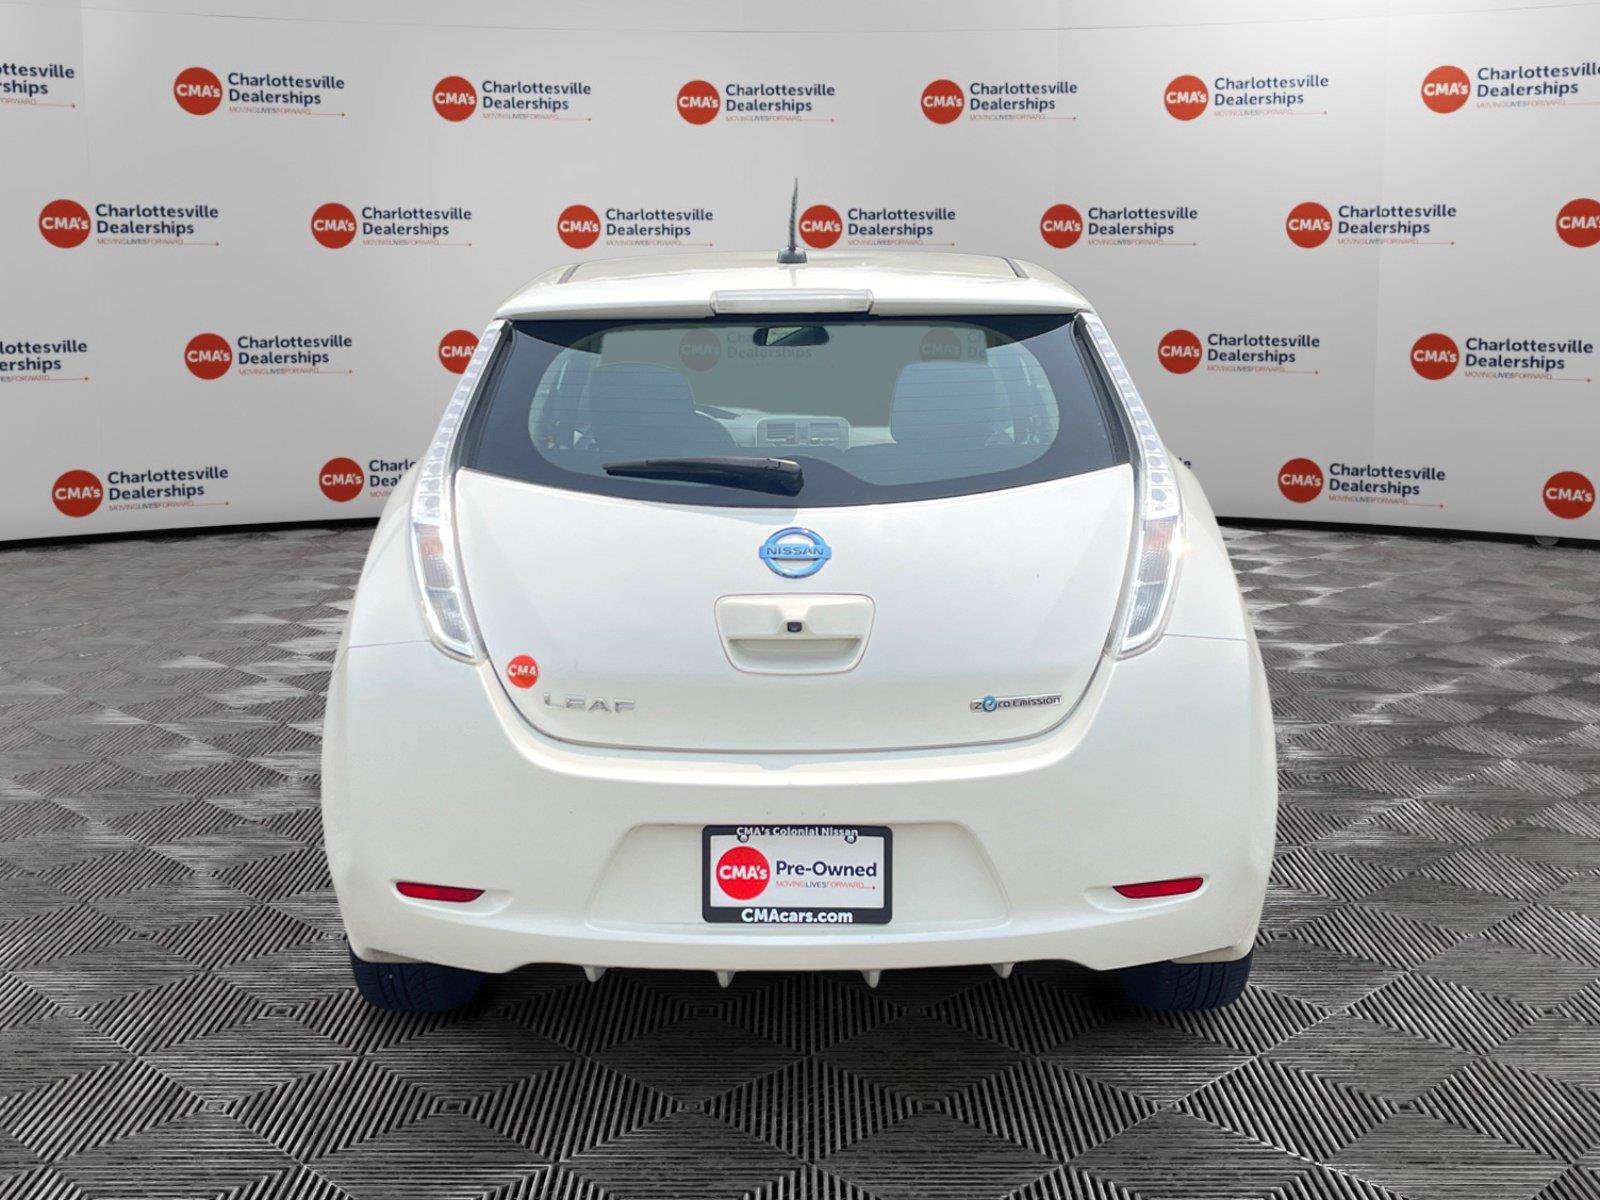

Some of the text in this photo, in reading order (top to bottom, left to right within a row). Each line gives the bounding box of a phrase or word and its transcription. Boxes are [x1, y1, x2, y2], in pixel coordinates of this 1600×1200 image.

[228, 72, 344, 89] Charlottesville
[482, 80, 591, 94] Charlottesville
[1214, 75, 1328, 90] Charlottesville
[178, 84, 220, 97] CMA's
[726, 84, 835, 96] Charlottesville
[970, 82, 1077, 95] Charlottesville
[1425, 82, 1468, 97] CMA's
[1477, 82, 1578, 97] Dealerships
[229, 89, 321, 107] Dealerships
[435, 92, 474, 104] CMA's
[483, 96, 569, 112] Dealerships
[679, 96, 718, 108] CMA's
[924, 96, 962, 107] CMA's
[1166, 90, 1207, 104] CMA's
[1214, 92, 1304, 107] Dealerships
[726, 99, 812, 114] Dealerships
[970, 98, 1055, 112] Dealerships
[96, 204, 218, 218] Charlottesville
[362, 206, 471, 220] Charlottesville
[606, 208, 713, 221] Charlottesville
[848, 208, 955, 220] Charlottesville
[1088, 207, 1198, 220] Charlottesville
[1338, 204, 1456, 218] Charlottesville
[43, 217, 88, 229] CMA's
[97, 220, 194, 237] Dealerships
[314, 220, 354, 231] CMA's
[363, 222, 449, 238] Dealerships
[560, 220, 598, 232] CMA's
[801, 220, 840, 232] CMA's
[1043, 220, 1081, 231] CMA's
[1290, 219, 1330, 230] CMA's
[1338, 221, 1430, 237] Dealerships
[606, 224, 690, 238] Dealerships
[848, 223, 933, 238] Dealerships
[1088, 223, 1174, 238] Dealerships
[238, 335, 352, 349] Charlottesville
[1208, 334, 1320, 347] Charlottesville
[1466, 338, 1593, 353] Charlottesville
[188, 350, 231, 362] CMA's
[239, 351, 329, 366] Dealerships
[1161, 346, 1200, 357] CMA's
[1208, 348, 1296, 365] Dealerships
[1414, 350, 1457, 362] CMA's
[1466, 354, 1564, 372] Dealerships
[108, 468, 228, 484] Charlottesville
[1330, 463, 1445, 480] Charlottesville
[322, 474, 362, 485] CMA's
[1280, 474, 1322, 486] CMA's
[56, 487, 100, 500] CMA's
[109, 484, 204, 500] Dealerships
[1330, 478, 1419, 498] Dealerships
[1546, 488, 1592, 502] CMA's
[766, 546, 824, 556] NISSAN
[544, 692, 635, 712] LEAF
[736, 826, 858, 837] CMA's Colonial Nissan
[720, 865, 768, 880] CMA's
[776, 860, 877, 877] Pre-Owned
[741, 908, 854, 923] CMAcars.com
